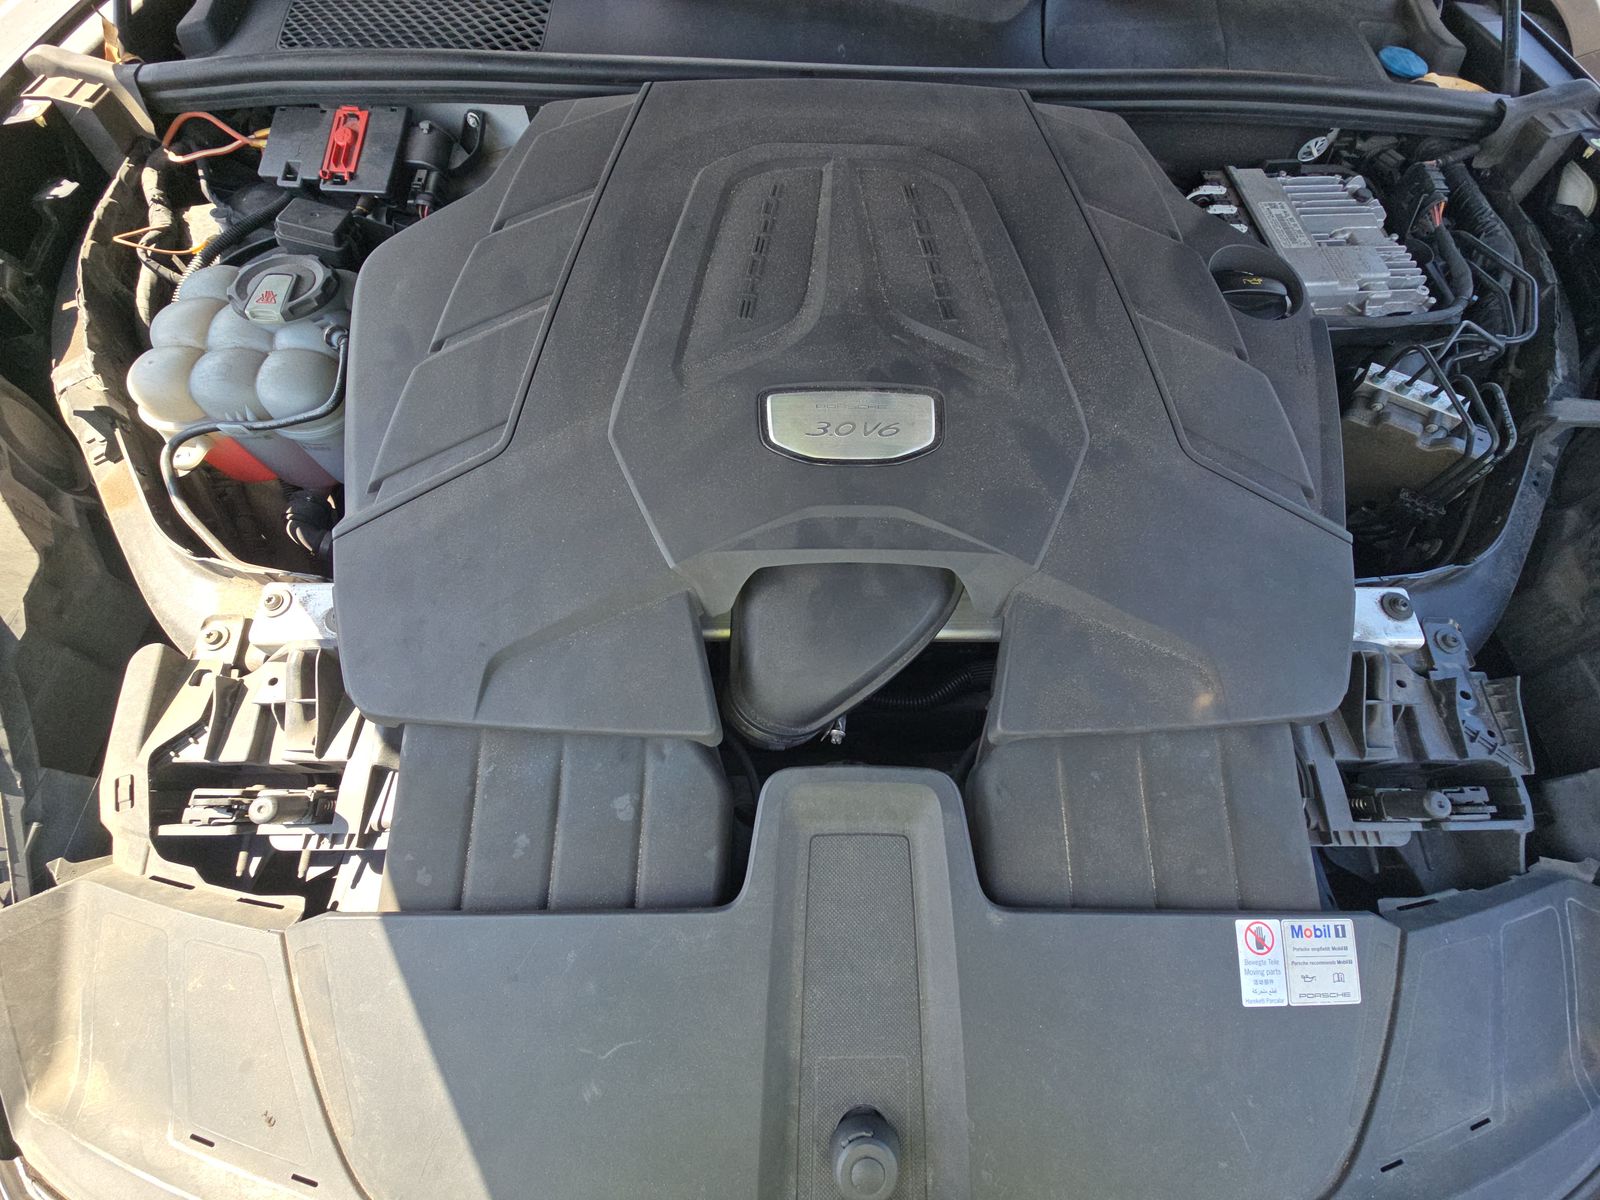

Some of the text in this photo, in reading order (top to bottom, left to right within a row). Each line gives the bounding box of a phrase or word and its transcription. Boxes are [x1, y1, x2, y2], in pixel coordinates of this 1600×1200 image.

[805, 421, 900, 438] 3.0 V6
[1290, 924, 1346, 939] Mobil 1
[1244, 968, 1281, 977] Moving parts
